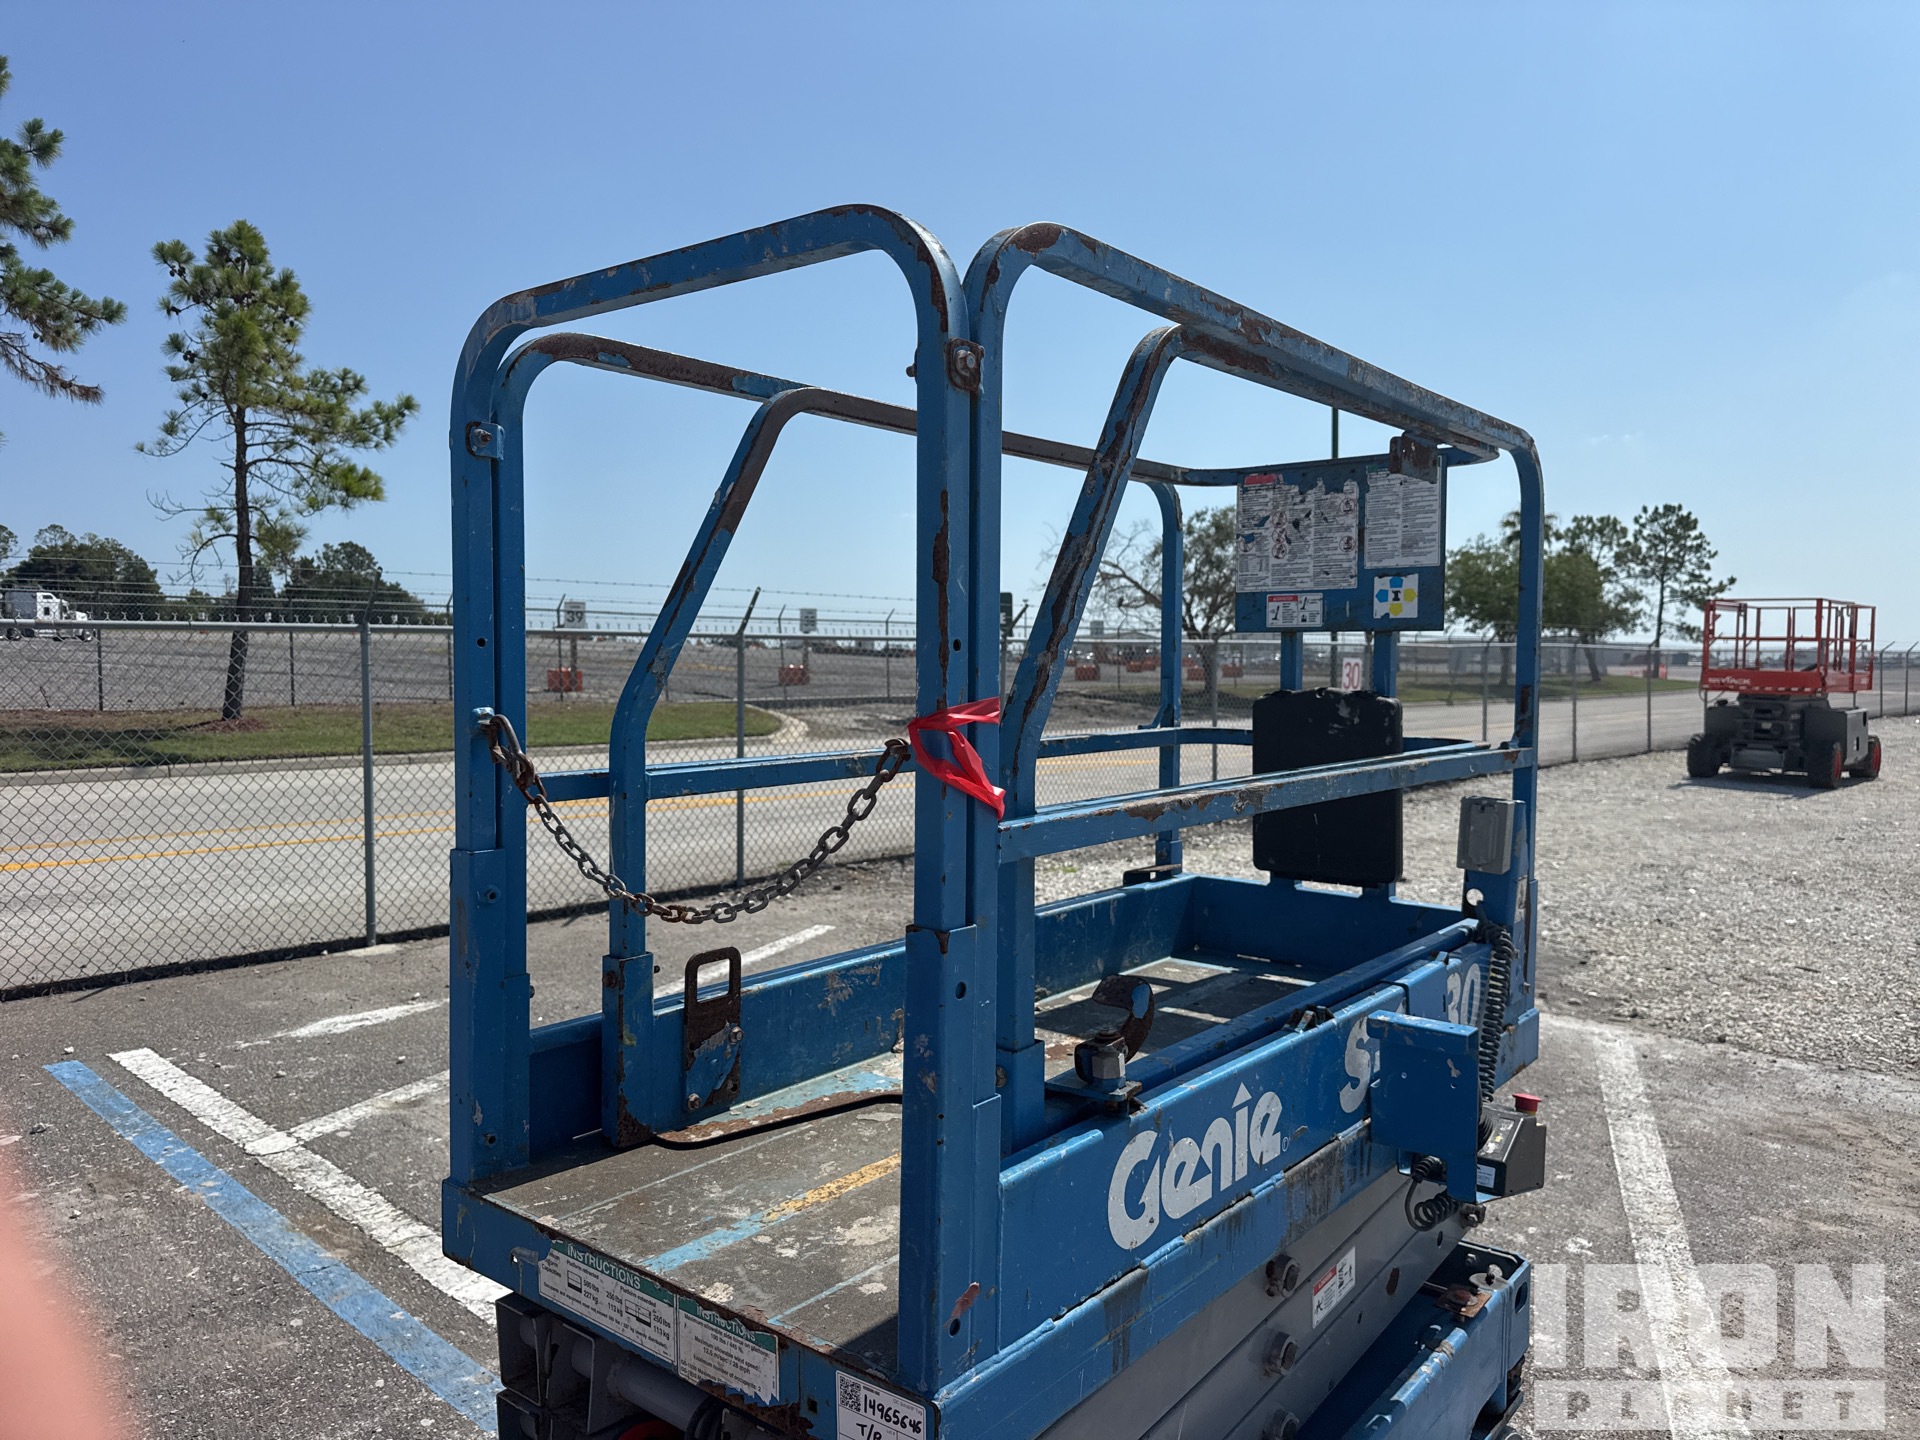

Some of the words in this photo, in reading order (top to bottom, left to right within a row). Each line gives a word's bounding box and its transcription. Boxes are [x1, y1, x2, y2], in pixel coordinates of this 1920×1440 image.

[567, 610, 584, 623] 39
[1343, 662, 1360, 689] 30
[1107, 1081, 1283, 1250] Genie
[541, 1263, 562, 1278] Capacities
[567, 1243, 641, 1290] INSTRUCTIONS
[592, 1284, 600, 1293] lbs
[583, 1289, 593, 1301] 227
[592, 1295, 599, 1305] kg
[607, 1302, 617, 1312] 113
[616, 1307, 623, 1317] kg
[653, 1314, 662, 1325] 250
[663, 1318, 671, 1329] lbs
[684, 1313, 704, 1327] Maximum
[662, 1330, 670, 1341] kg
[694, 1335, 714, 1349] Maximum
[864, 1394, 923, 1434] 14965646
